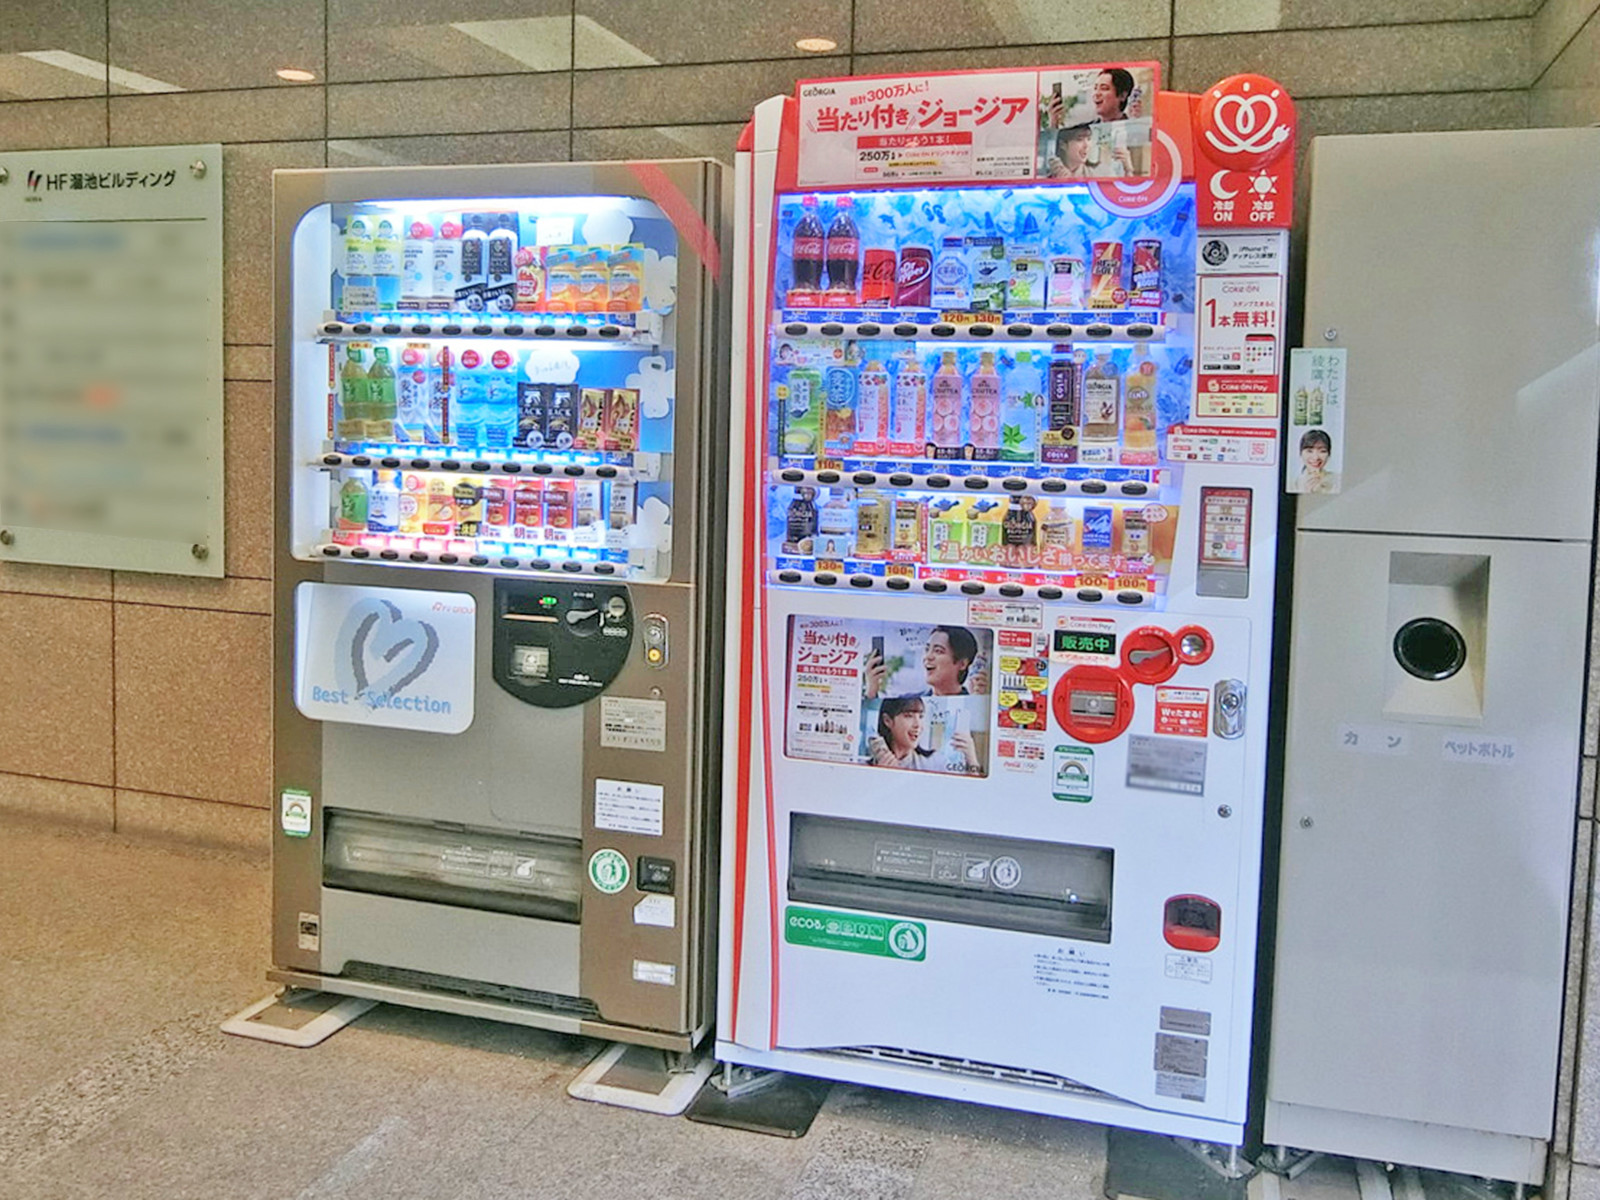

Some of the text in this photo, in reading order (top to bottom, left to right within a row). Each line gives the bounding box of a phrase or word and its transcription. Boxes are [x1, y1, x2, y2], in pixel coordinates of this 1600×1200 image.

[817, 97, 1030, 133] 当たり付き ジョージア
[1213, 212, 1275, 222] ON OFF
[804, 629, 857, 647] 当たり付き
[1061, 635, 1110, 652] 販売中
[798, 646, 859, 666] ジョージア
[312, 686, 452, 715] Best Selection
[1444, 740, 1515, 759] ペットボトル
